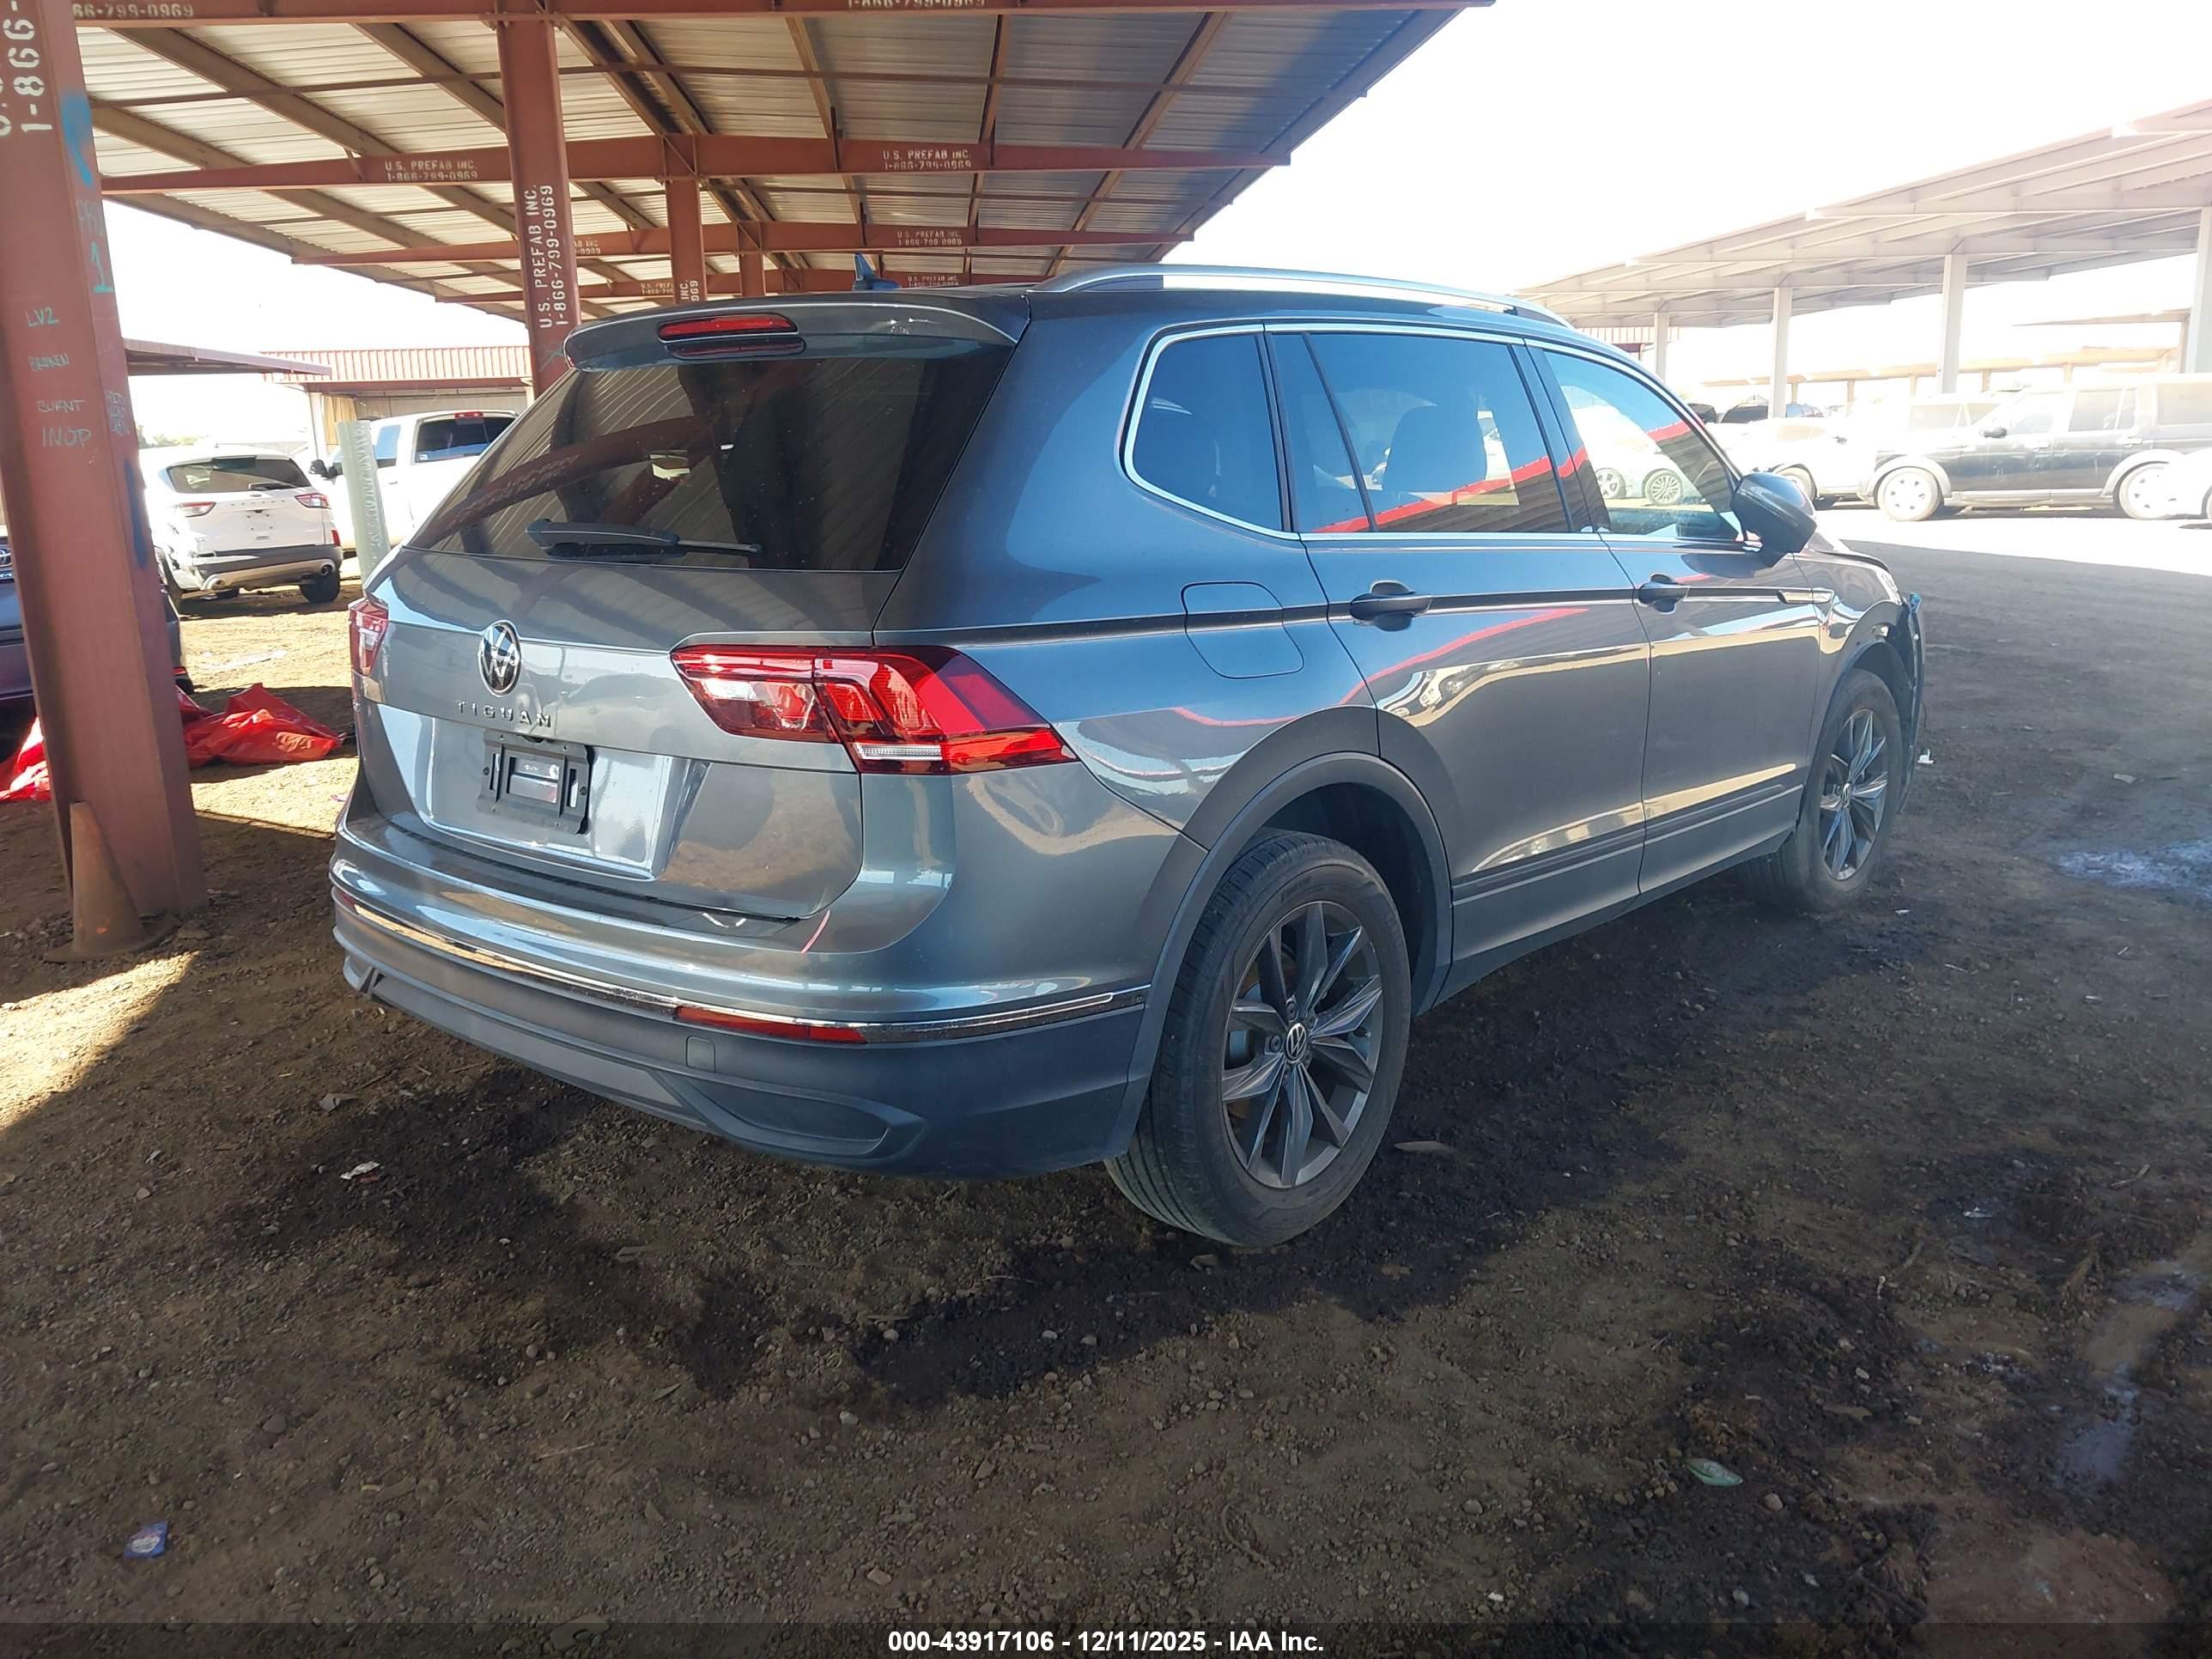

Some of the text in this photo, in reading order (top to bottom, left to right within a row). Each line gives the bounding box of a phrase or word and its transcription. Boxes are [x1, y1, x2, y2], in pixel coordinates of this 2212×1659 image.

[908, 149, 948, 160] PREFAB
[410, 159, 453, 171] PREFAB
[525, 185, 553, 328] U.S. PREFAB INC.
[539, 185, 569, 325] 1-866-799-0969
[25, 307, 59, 327] LV2
[42, 428, 91, 448] INOP
[456, 700, 551, 728] TIGUAN
